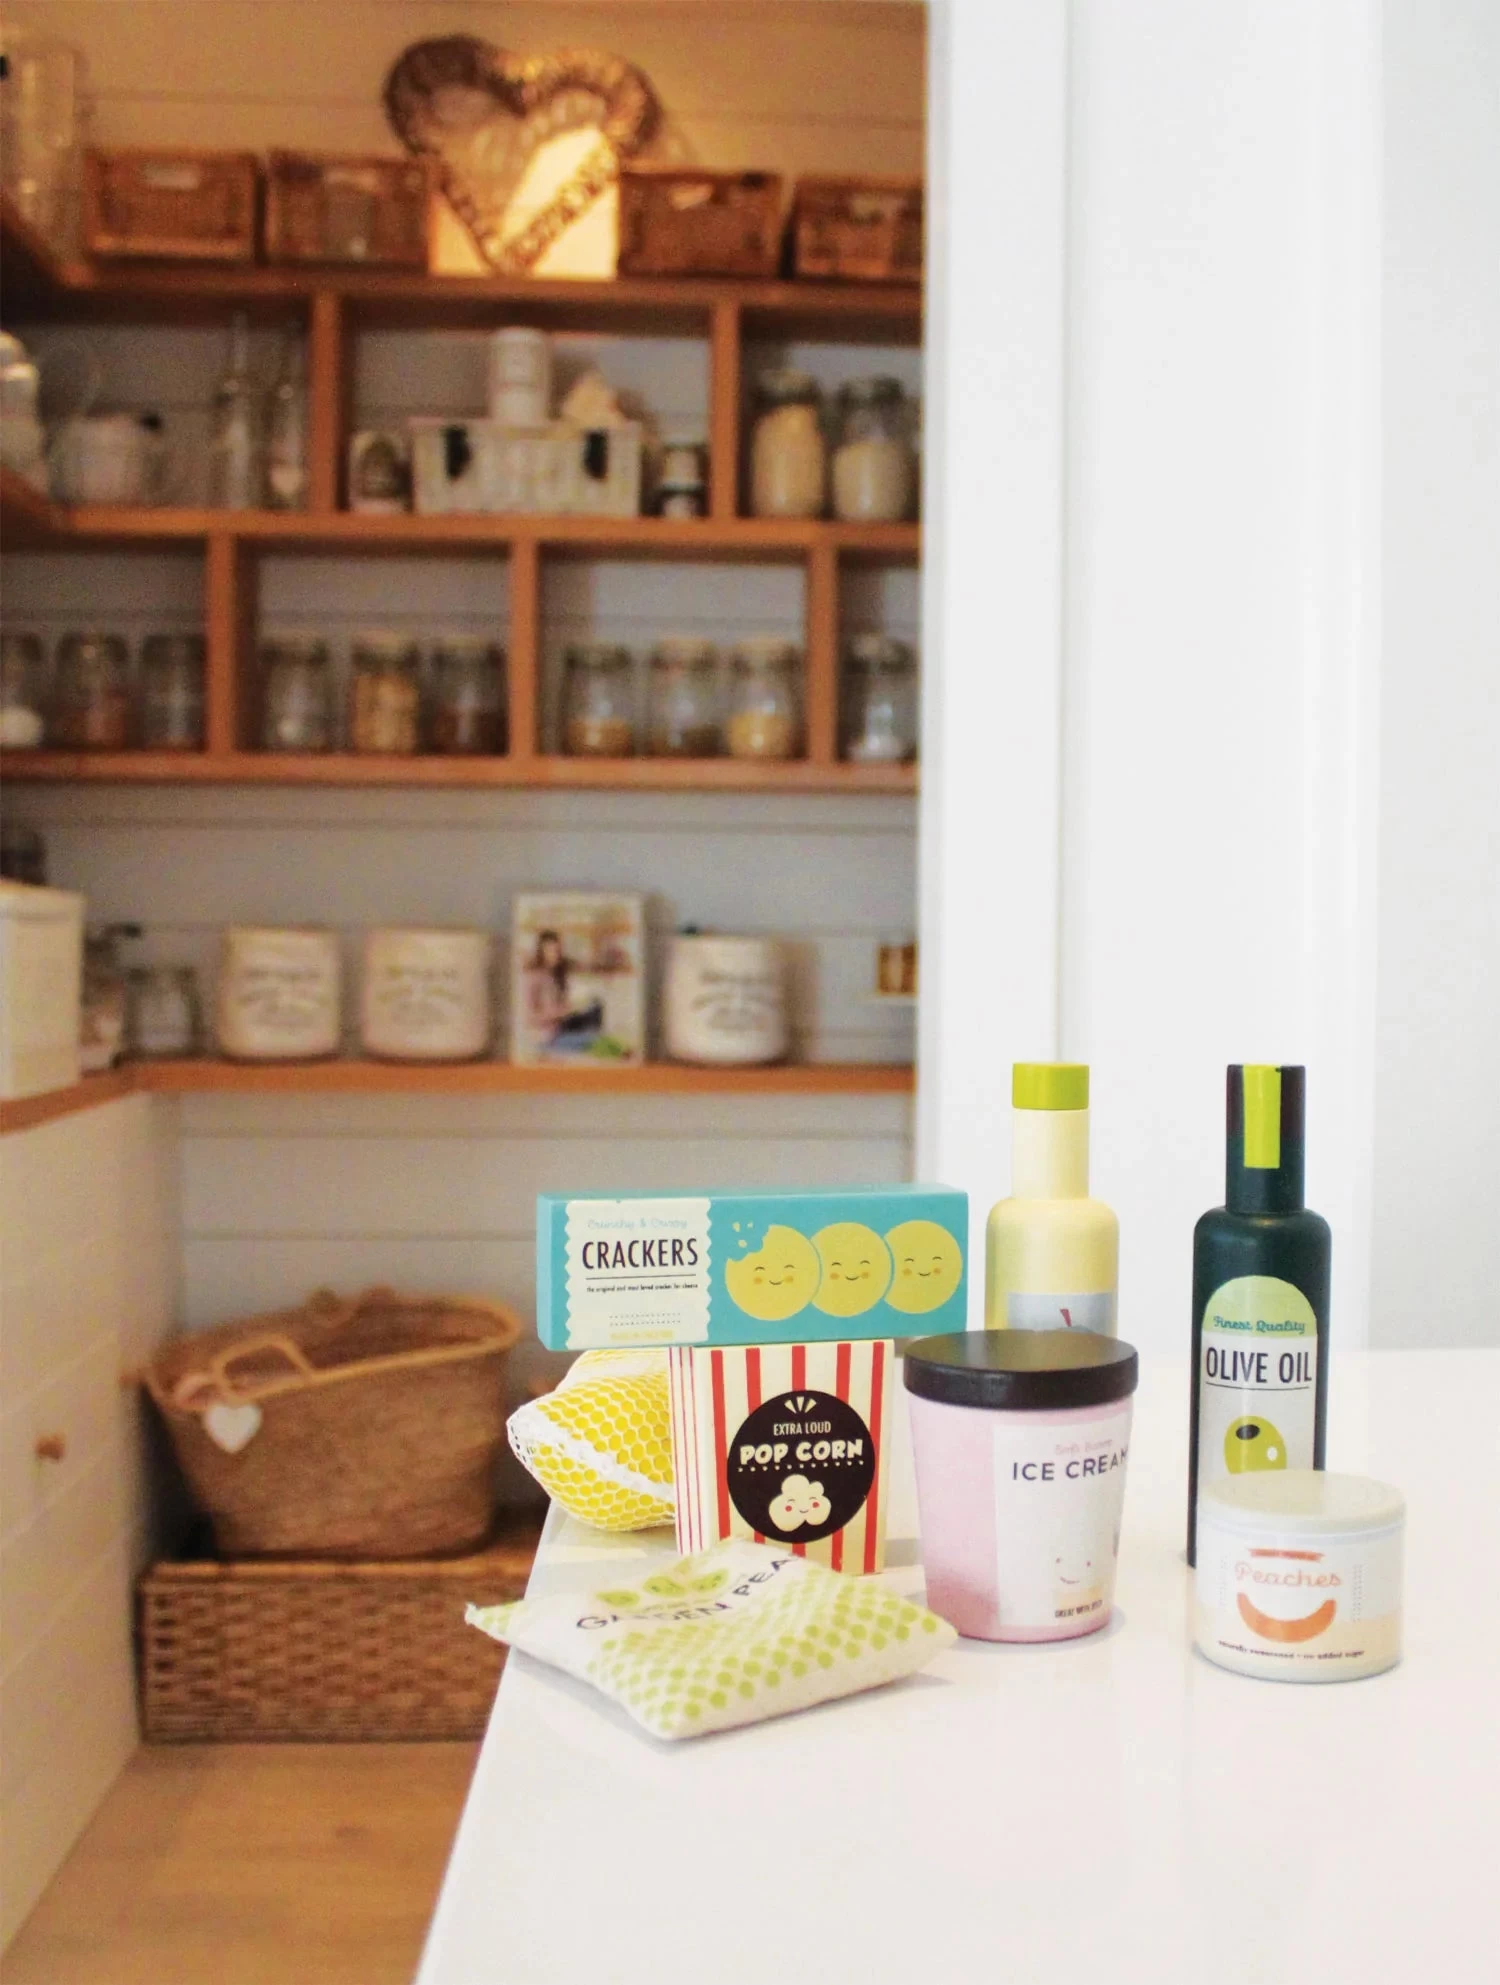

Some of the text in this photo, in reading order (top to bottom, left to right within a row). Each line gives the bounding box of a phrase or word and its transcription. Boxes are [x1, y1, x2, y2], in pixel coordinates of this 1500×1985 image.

[582, 1238, 698, 1269] CRACKERS
[1213, 1315, 1305, 1335] Finest Quality
[1206, 1346, 1312, 1384] OLIVE OIL
[773, 1420, 832, 1436] EXTRA LOUD
[739, 1438, 864, 1465] POP CORN
[1012, 1462, 1056, 1481] ICE
[1065, 1445, 1129, 1479] CREAM
[1234, 1561, 1342, 1588] Peaches
